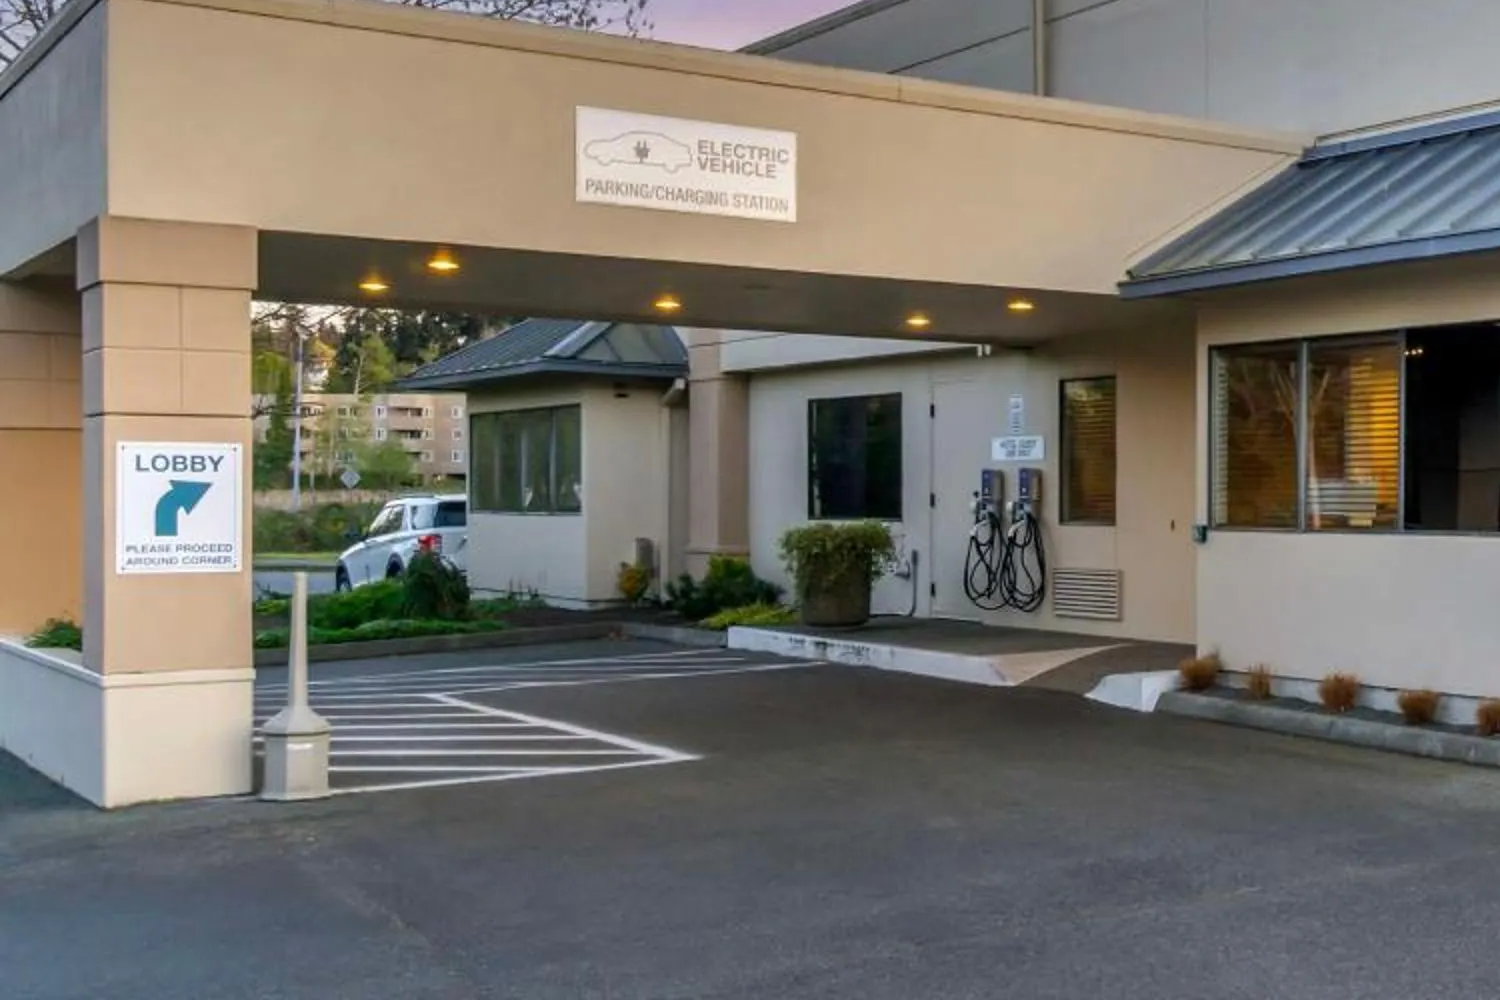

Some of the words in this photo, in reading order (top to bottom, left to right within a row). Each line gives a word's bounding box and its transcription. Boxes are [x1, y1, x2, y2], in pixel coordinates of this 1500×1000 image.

[697, 139, 790, 164] ELECTRIC
[697, 156, 777, 179] VEHICLE
[585, 178, 729, 207] PARKING/CHARGING
[733, 193, 789, 213] STATION
[135, 454, 225, 473] LOBBY
[126, 543, 172, 554] PLEASE
[176, 543, 233, 553] PROCEED
[126, 556, 178, 566] AROUND
[182, 555, 232, 565] CORNER
